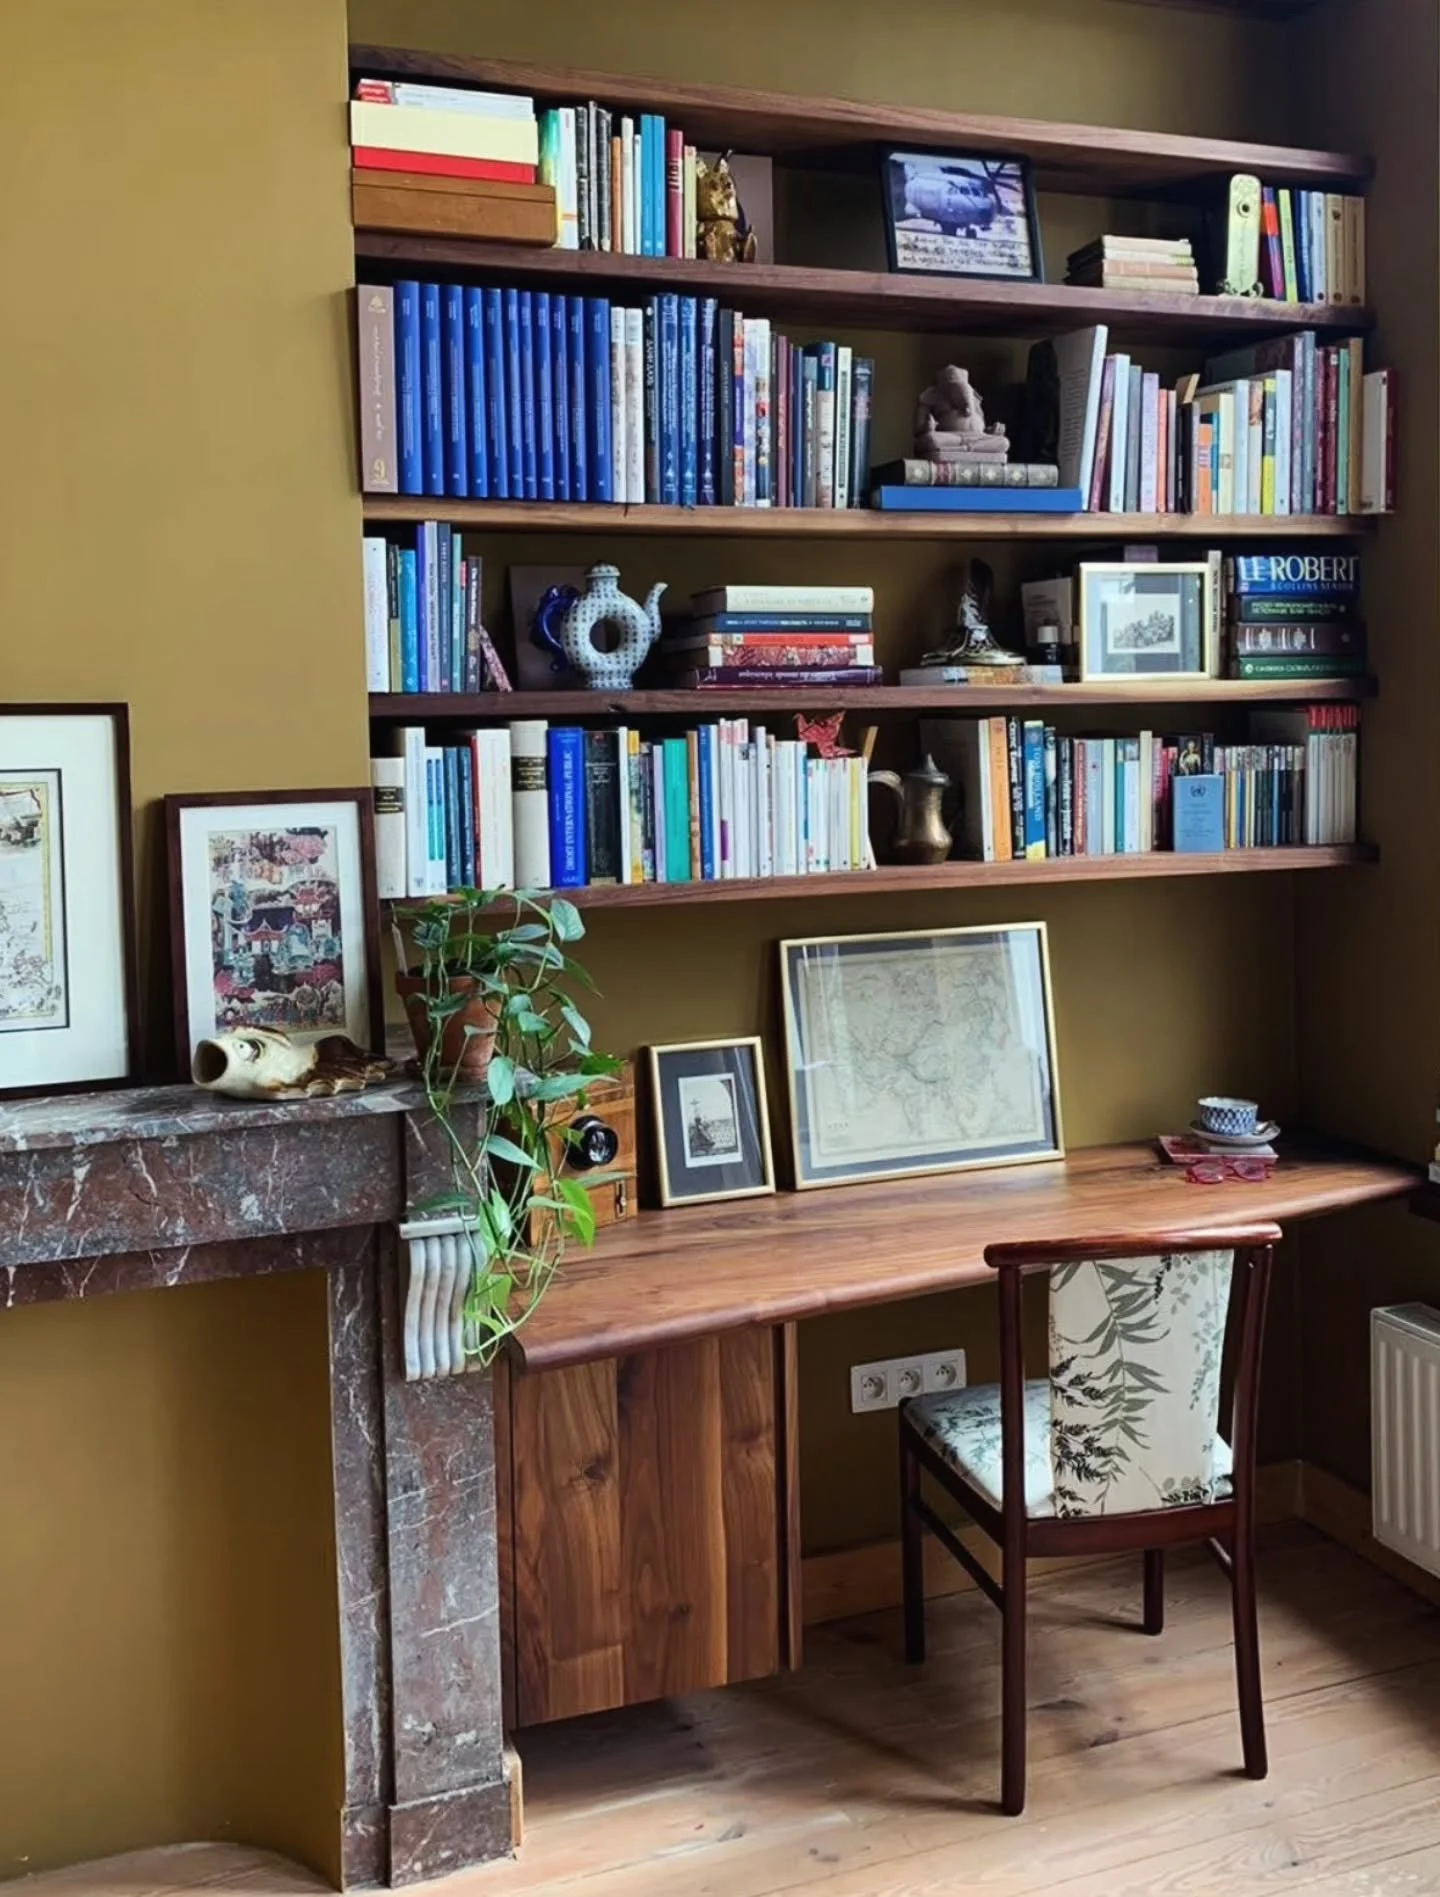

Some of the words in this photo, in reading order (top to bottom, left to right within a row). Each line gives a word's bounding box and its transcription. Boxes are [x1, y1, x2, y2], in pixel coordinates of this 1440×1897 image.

[1239, 556, 1266, 581] LE
[1269, 555, 1359, 581] ROBERT
[1278, 582, 1318, 590] COLLINS
